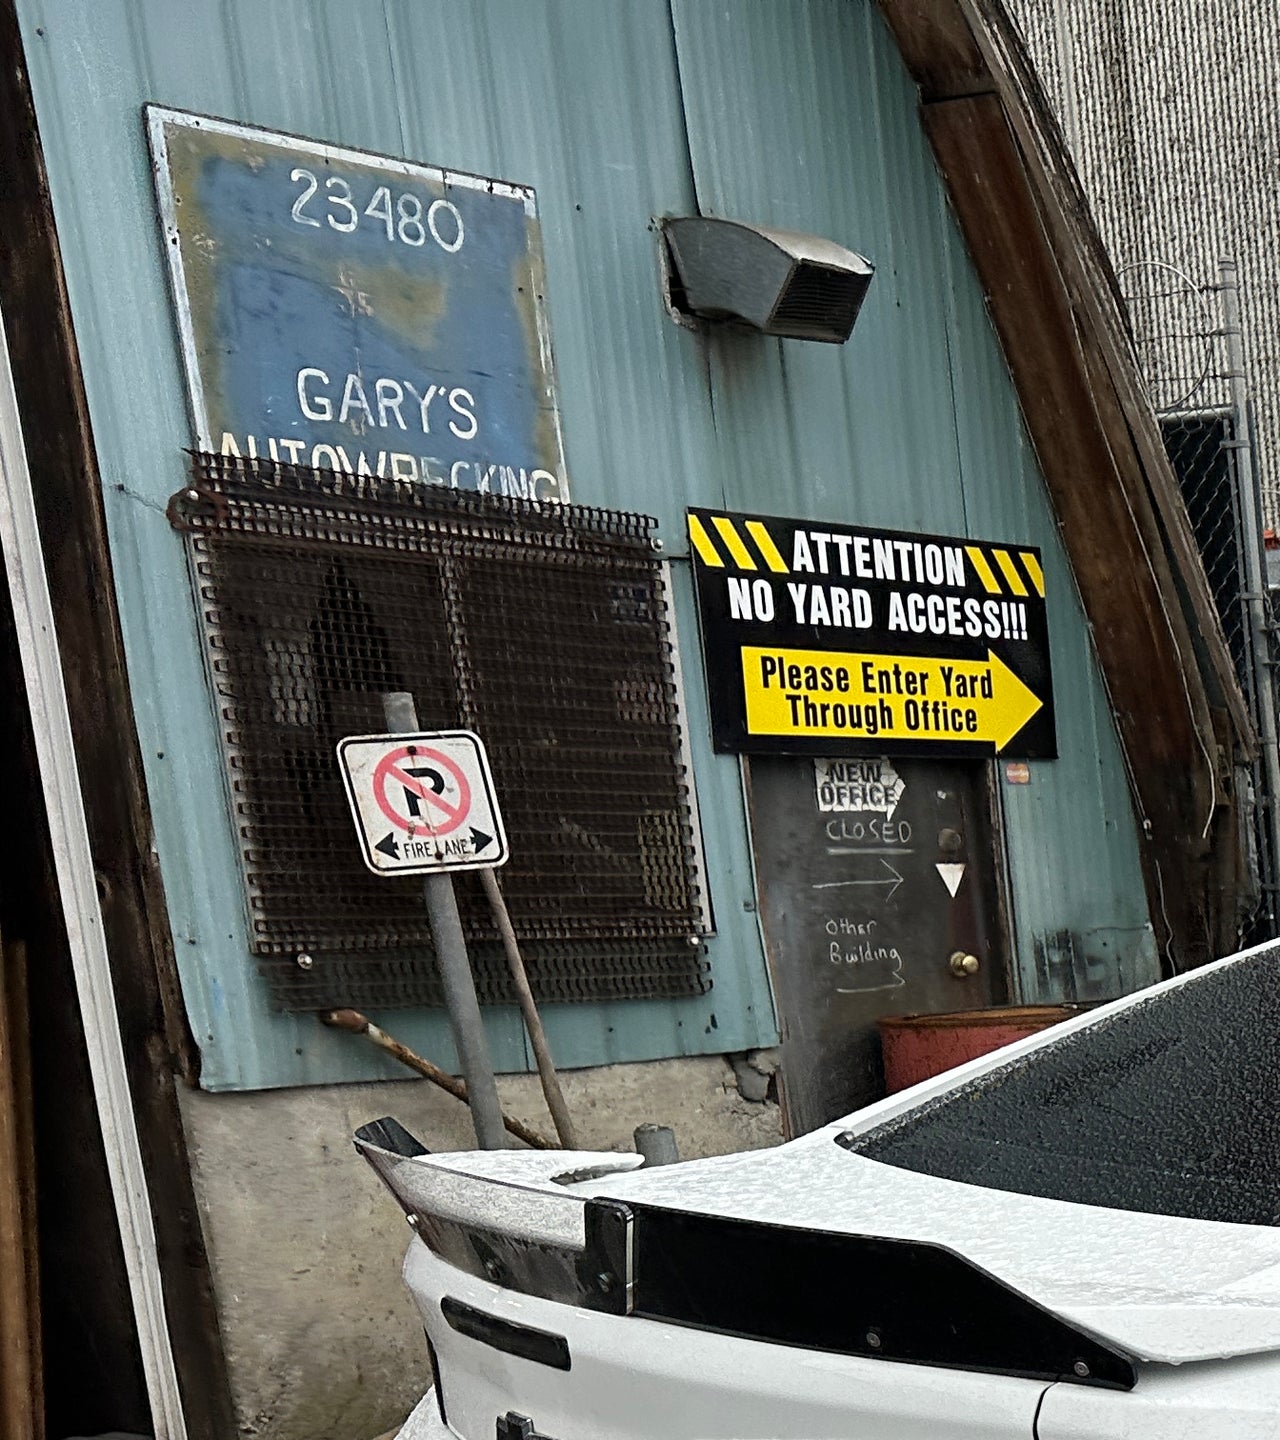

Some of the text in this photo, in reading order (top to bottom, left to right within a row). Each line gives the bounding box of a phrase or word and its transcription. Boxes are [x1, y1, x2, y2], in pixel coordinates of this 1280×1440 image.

[290, 168, 466, 254] 23480
[296, 367, 479, 441] GARY'S
[793, 529, 967, 588] ATTENTION
[728, 577, 1029, 641] NO YARD ACCESS!!!
[760, 655, 994, 699] Please Enter Yard
[785, 694, 978, 735] Through Office
[827, 761, 882, 783] NEW
[820, 783, 897, 807] OFFICE
[825, 818, 912, 843] CLOSED
[404, 839, 470, 859] FIRE LANE
[825, 918, 877, 936] Other
[830, 942, 902, 971] Building
